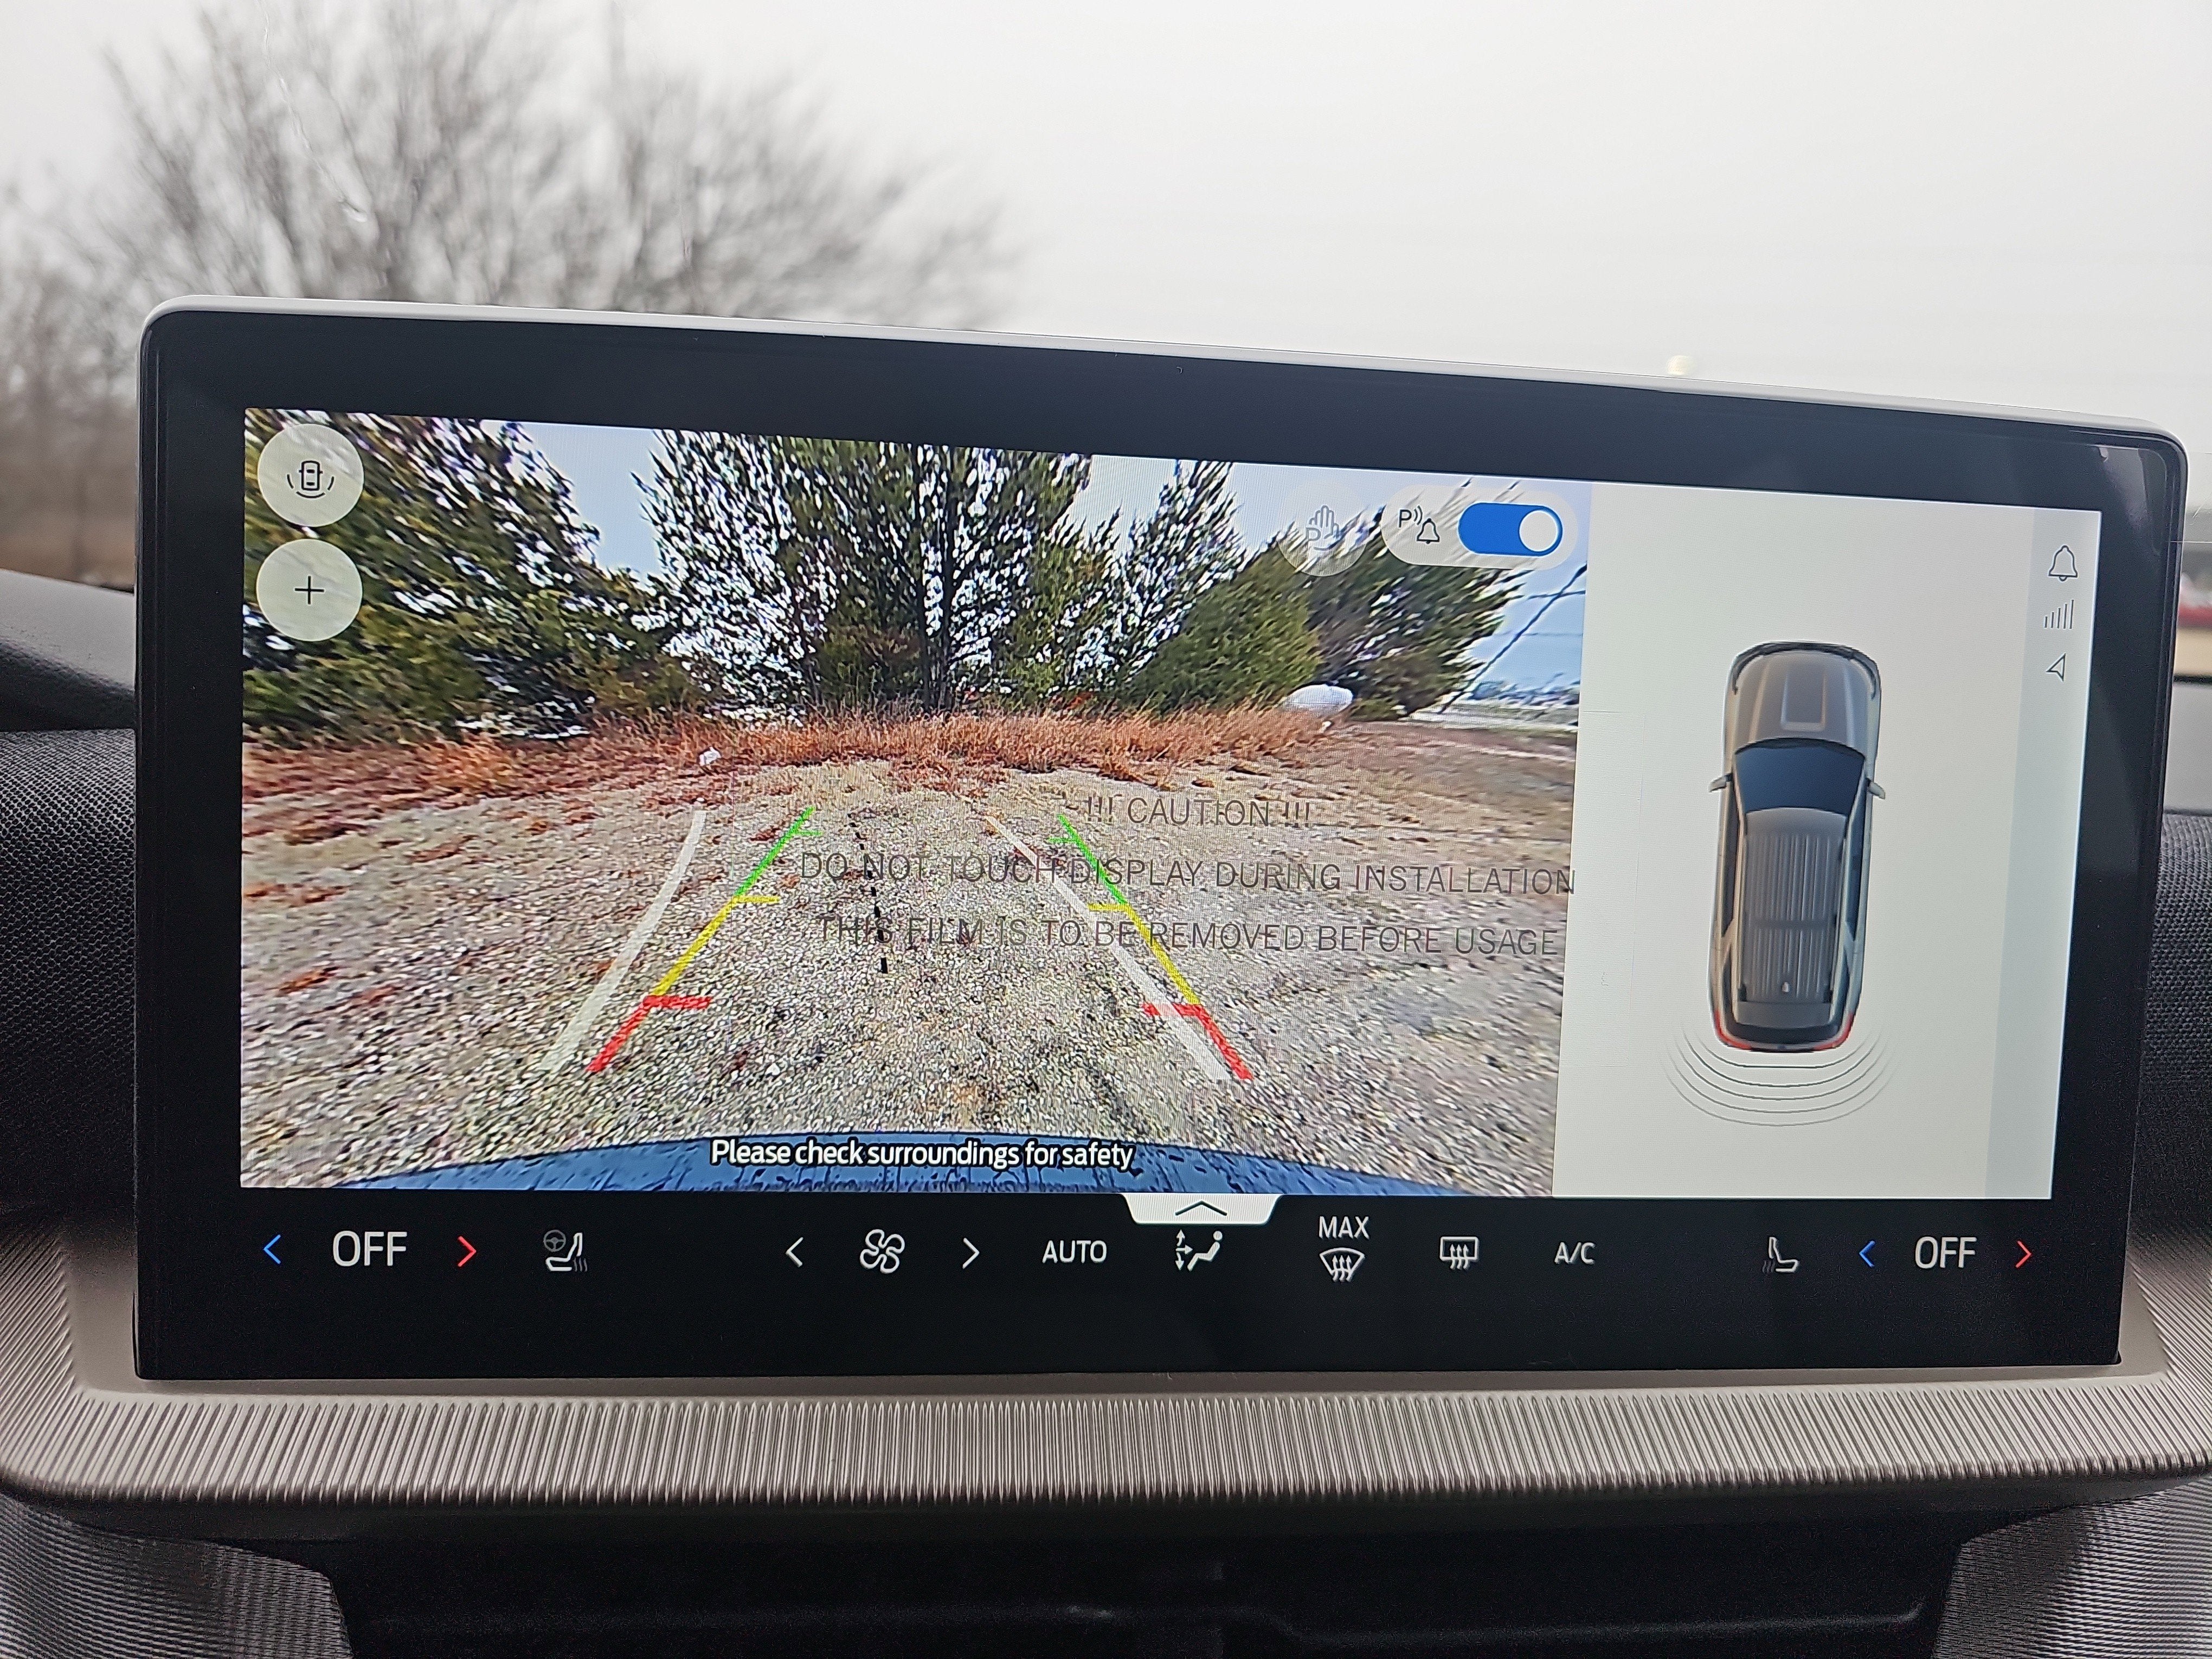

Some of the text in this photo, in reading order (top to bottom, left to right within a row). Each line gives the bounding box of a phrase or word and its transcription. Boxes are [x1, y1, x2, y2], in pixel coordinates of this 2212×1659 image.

[1127, 797, 1270, 827] CAUTION
[801, 852, 1574, 895] DO NOT TOUCH DISPLAY DURING INSTALLATION
[818, 915, 1558, 956] THIS FILM IS TO BE REMOVED BEFORE USAGE
[711, 1139, 1134, 1171] Please check surroundings for safety
[1318, 1216, 1369, 1239] MAX
[332, 1230, 408, 1266] OFF
[1041, 1239, 1108, 1263] AUTO
[1554, 1242, 1596, 1265] A/C
[1914, 1236, 1977, 1269] OFF
